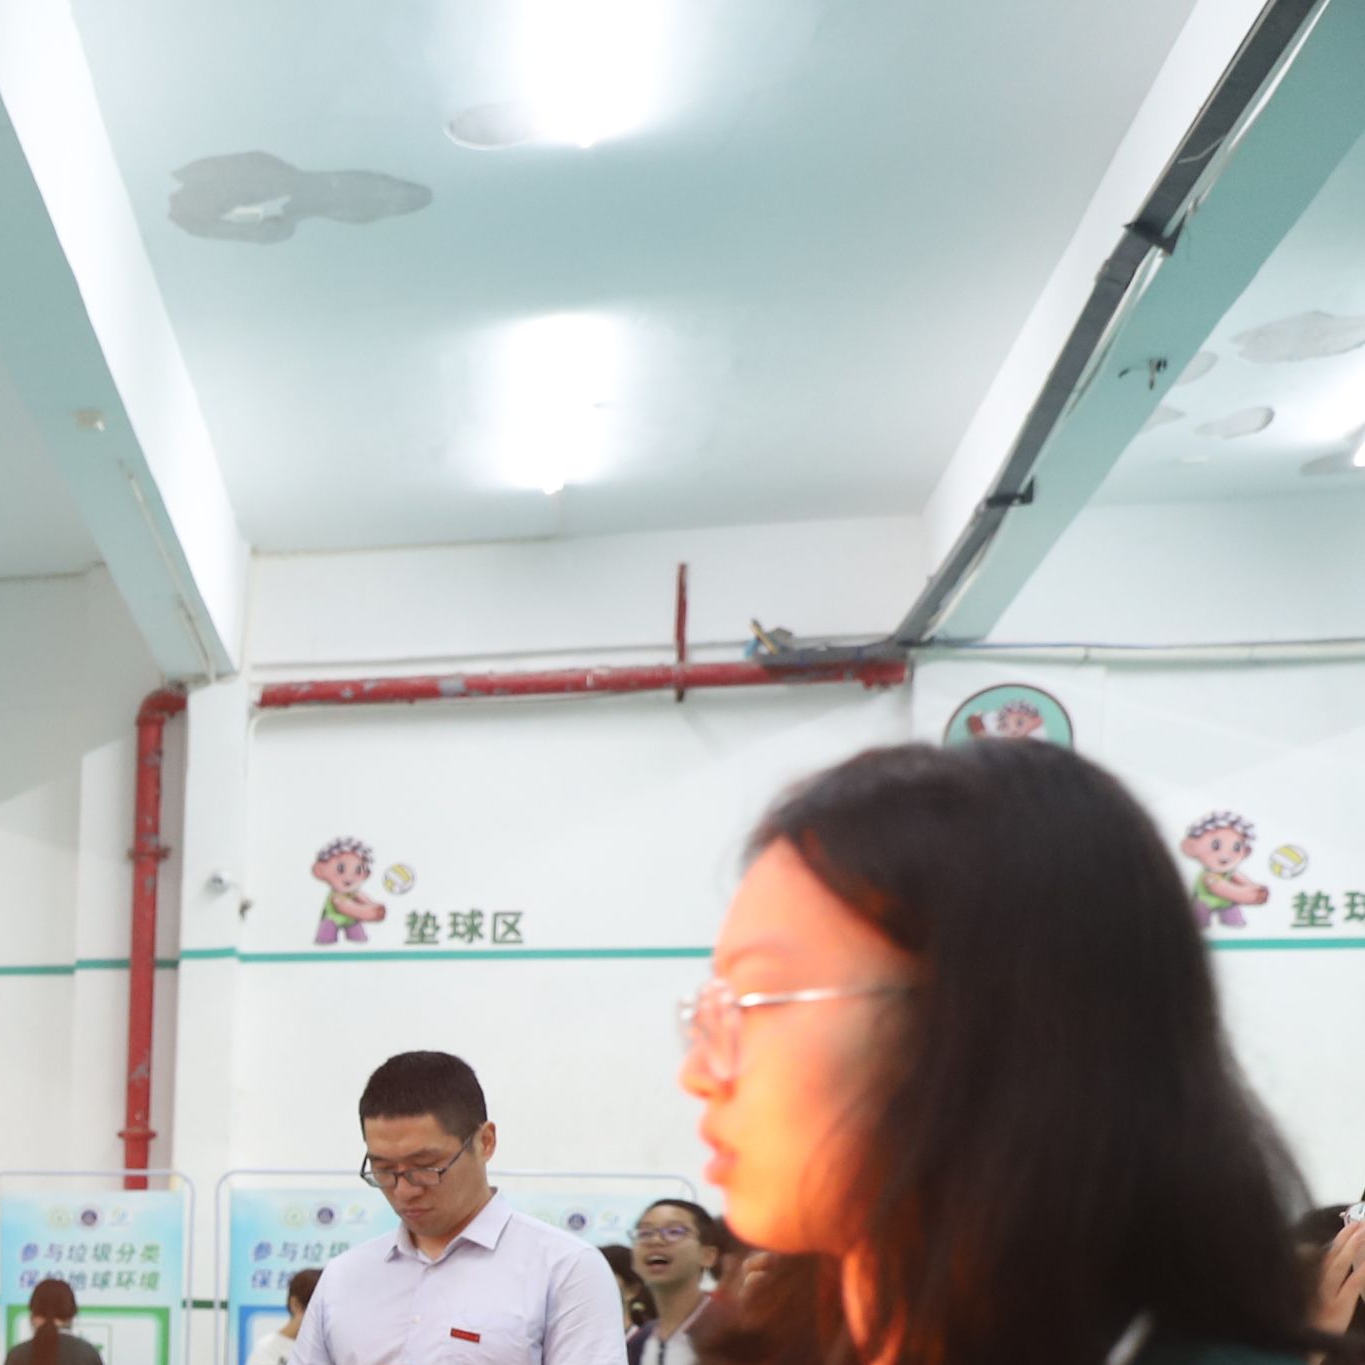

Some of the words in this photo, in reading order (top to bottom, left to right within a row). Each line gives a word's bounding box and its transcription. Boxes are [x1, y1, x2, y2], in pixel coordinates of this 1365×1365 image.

[404, 909, 524, 943] 垫球区
[20, 1242, 160, 1264] 参与垃圾分类
